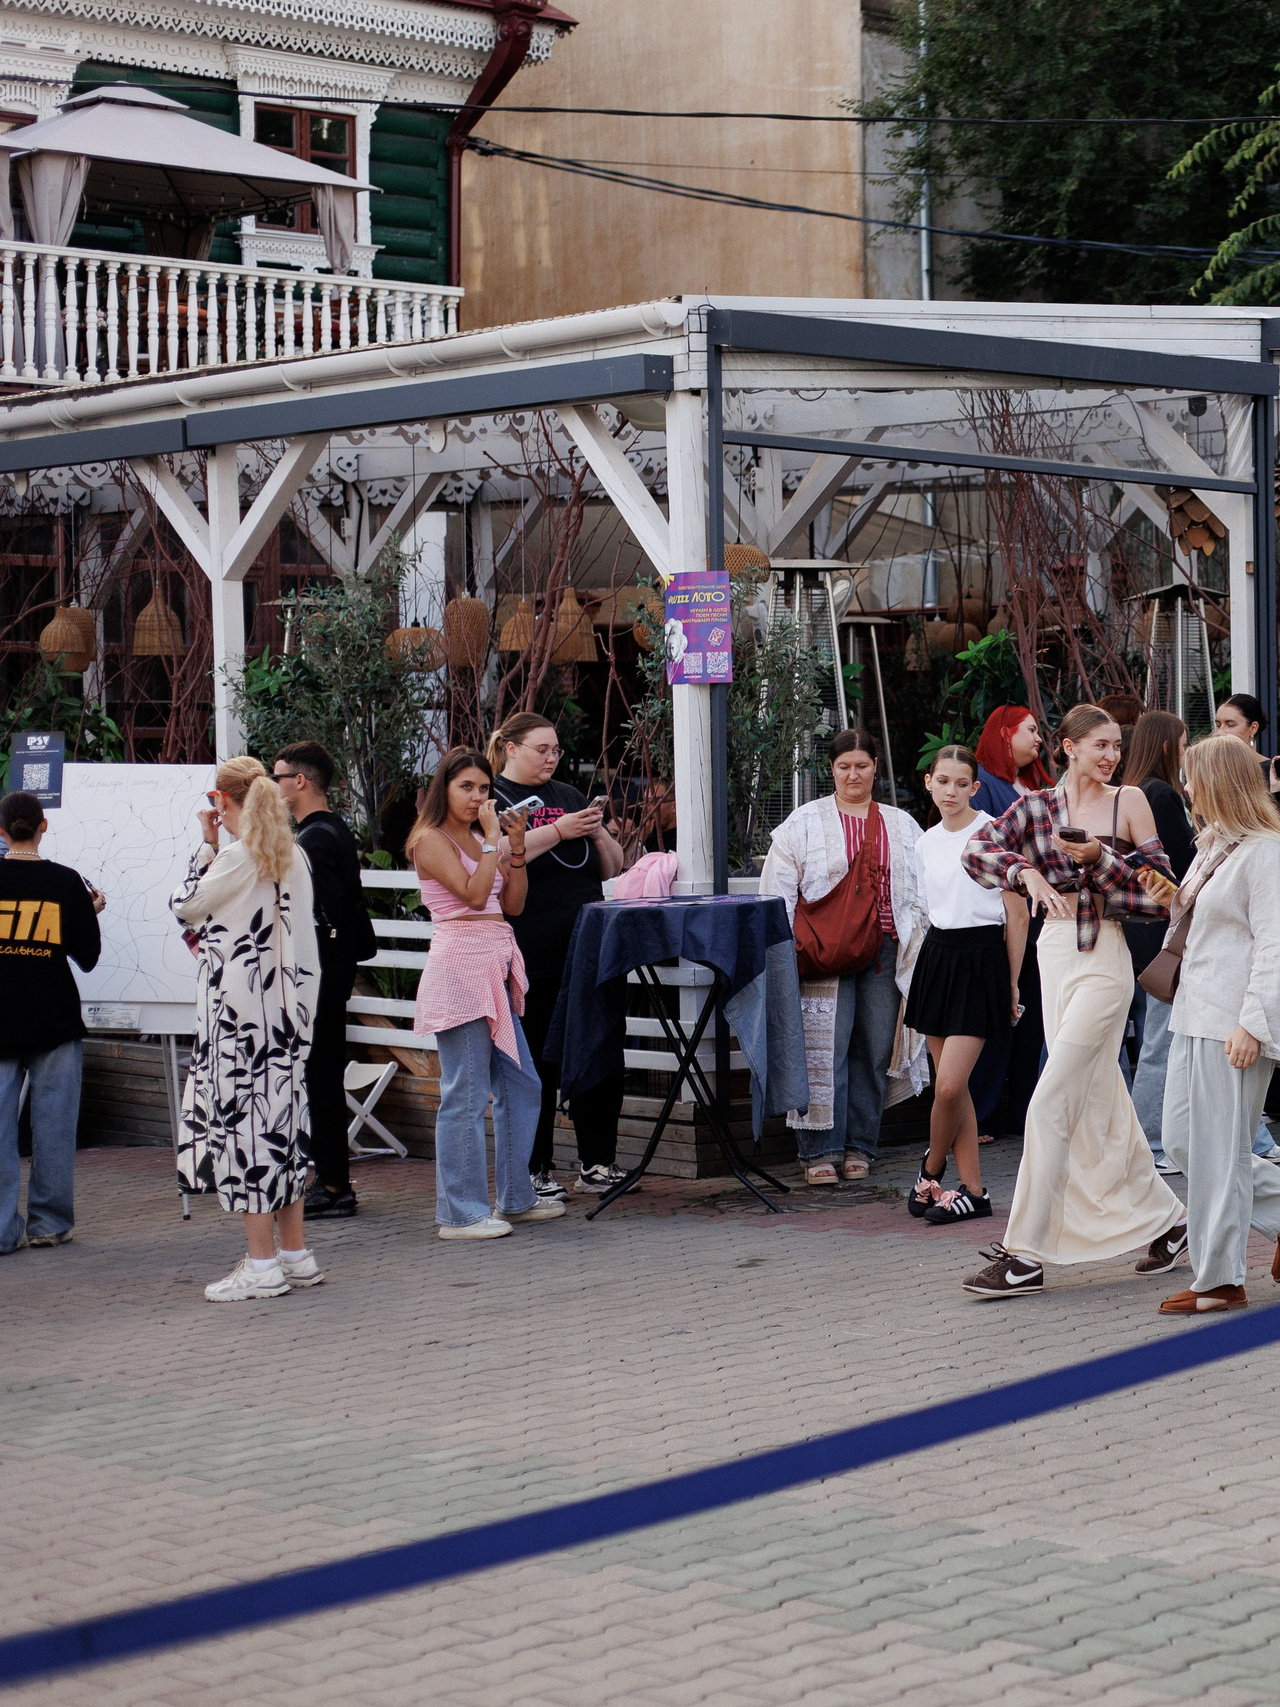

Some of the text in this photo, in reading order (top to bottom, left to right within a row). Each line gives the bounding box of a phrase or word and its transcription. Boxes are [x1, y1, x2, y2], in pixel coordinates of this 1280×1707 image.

[691, 591, 725, 602] ЛОТО
[72, 774, 125, 795] Нарисуй
[533, 817, 560, 828] ЛОТ
